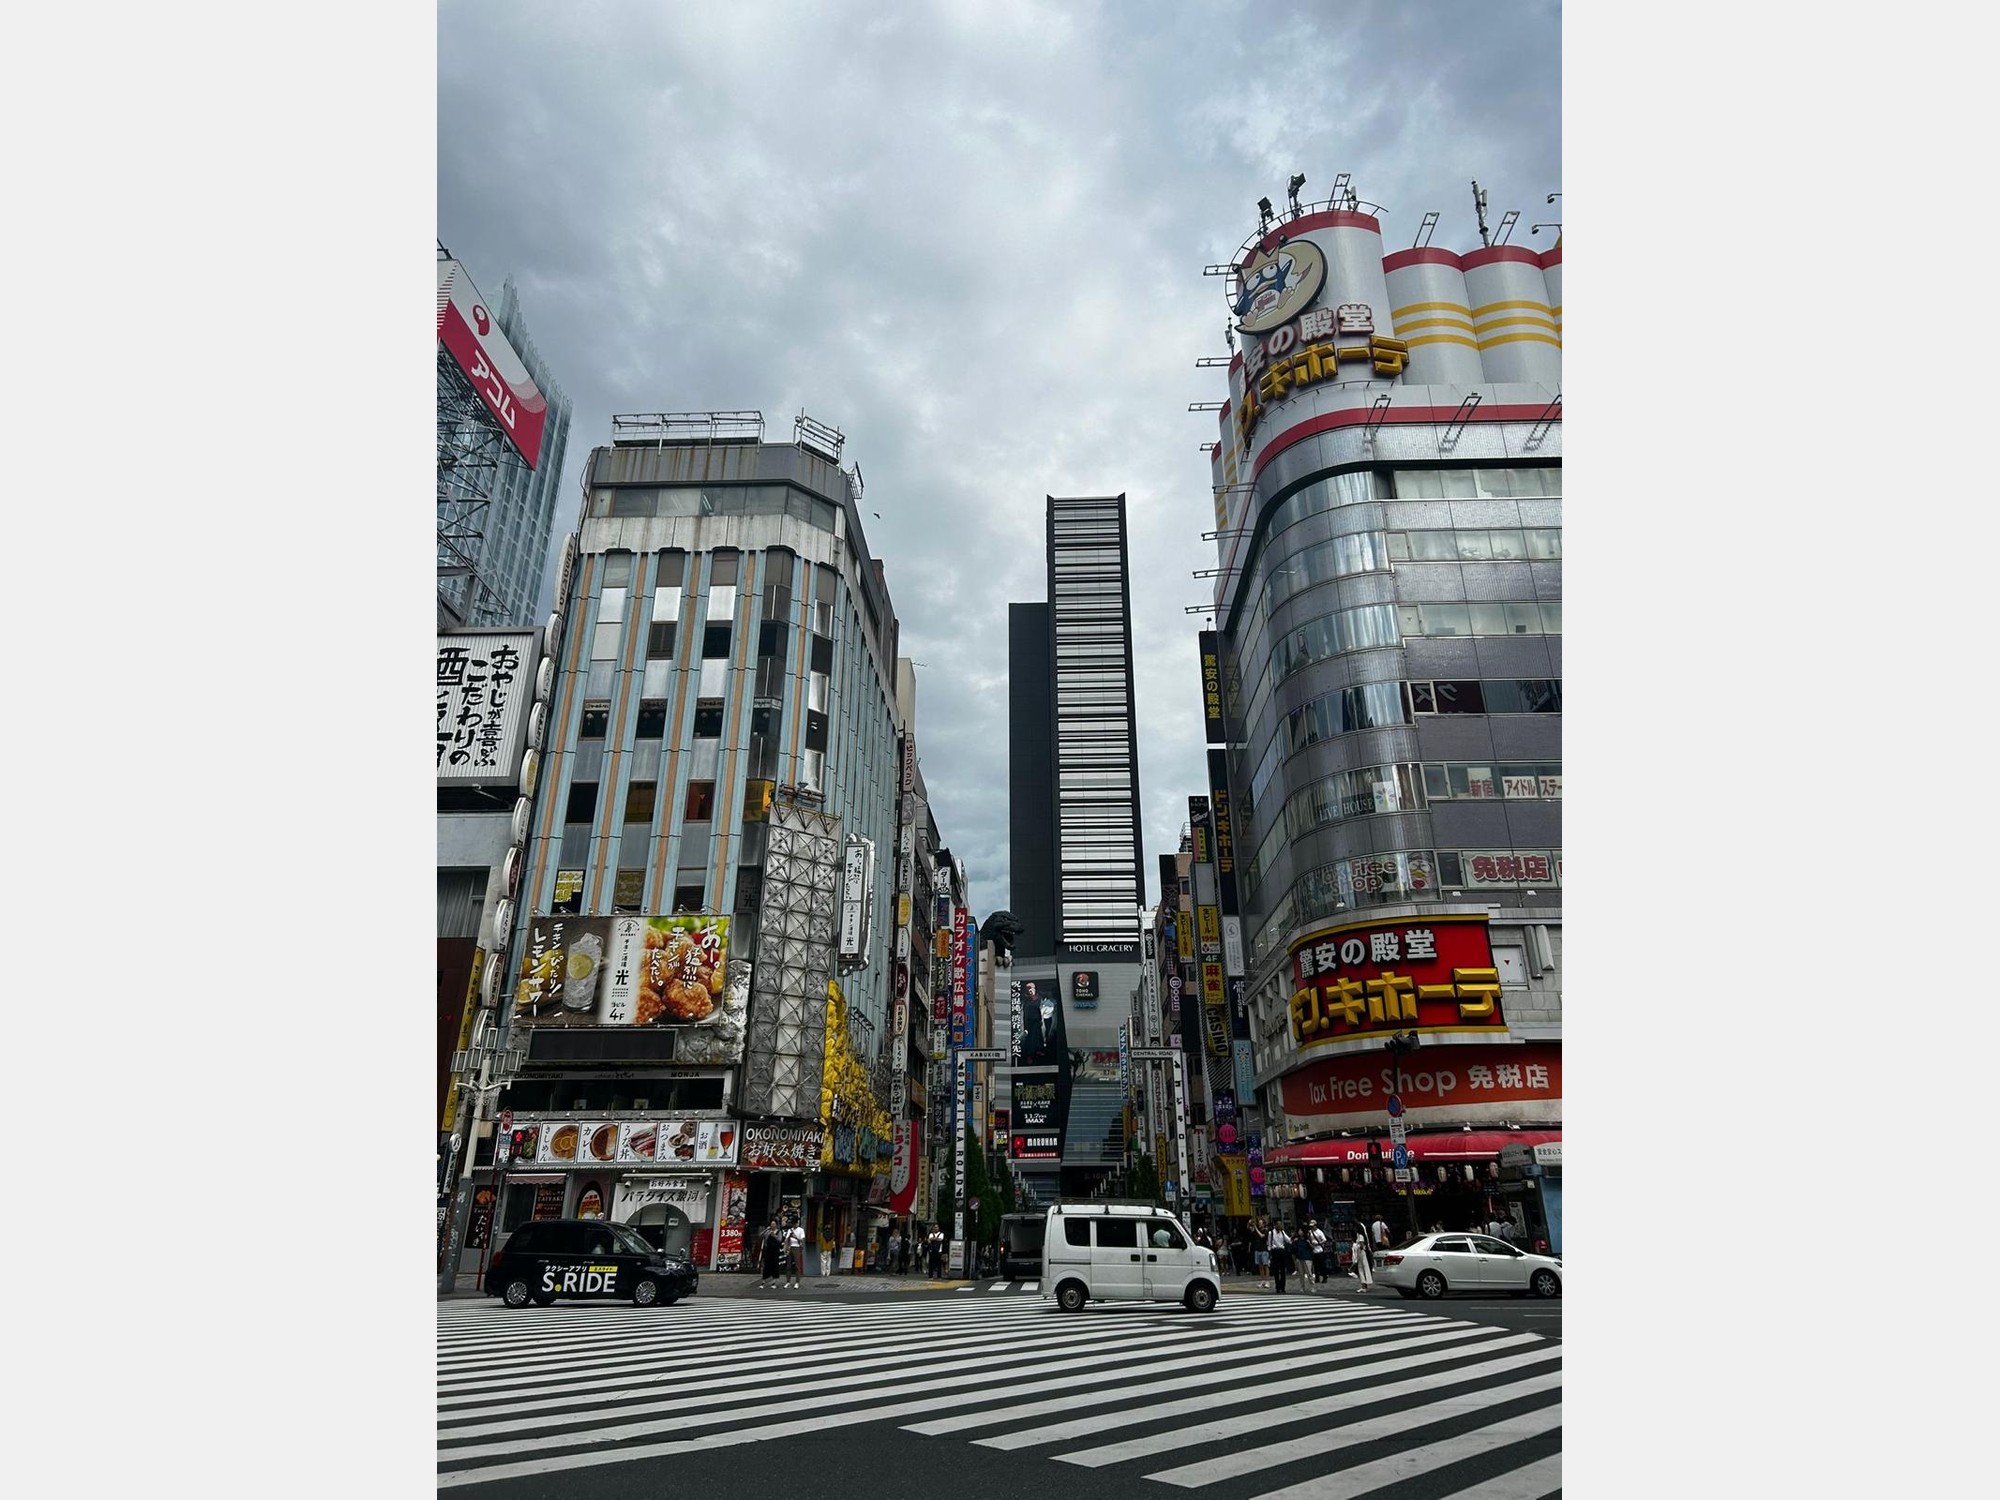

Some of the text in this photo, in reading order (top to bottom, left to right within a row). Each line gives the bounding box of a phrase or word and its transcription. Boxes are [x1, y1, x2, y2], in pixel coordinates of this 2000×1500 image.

[1241, 303, 1375, 390] 安の殿堂
[471, 349, 515, 430] アコム
[1204, 653, 1221, 720] 驚安の殿堂
[449, 659, 489, 766] こだわりの
[1470, 779, 1492, 797] 新宿
[1504, 779, 1536, 797] アイドル
[1319, 797, 1374, 821] LIVE HOUSE
[1351, 858, 1397, 878] Free
[1471, 854, 1550, 882] 免税店
[954, 912, 966, 1008] カラオケ歌広場
[1069, 944, 1134, 952] HOTEL GRACERY
[1205, 954, 1218, 962] 4F
[1298, 929, 1438, 979] 驚安の殿堂
[528, 927, 547, 1018] レモンサワー
[615, 969, 630, 986] 光
[1206, 965, 1220, 991] 麻雀
[609, 1008, 625, 1022] 4F
[1207, 1006, 1228, 1053] CASINO
[1308, 1066, 1457, 1106] Tax Free Shop
[1466, 1063, 1549, 1090] 免税店
[658, 1123, 668, 1160] おつまみ
[699, 1132, 708, 1150] お酒
[746, 1128, 823, 1143] OKONOMIYAKI
[956, 1071, 965, 1186] GODZILLA ROAD
[1175, 1080, 1186, 1176] ゴジラロード
[541, 1125, 552, 1161] きしめん
[582, 1126, 593, 1159] カレー
[619, 1125, 631, 1161] うな丼
[749, 1144, 818, 1161] お好み焼き
[1027, 1137, 1058, 1147] MARUHAN
[1347, 1150, 1369, 1161] Don
[650, 1180, 686, 1189] お好み食堂
[541, 1271, 618, 1293] S.RIDE
